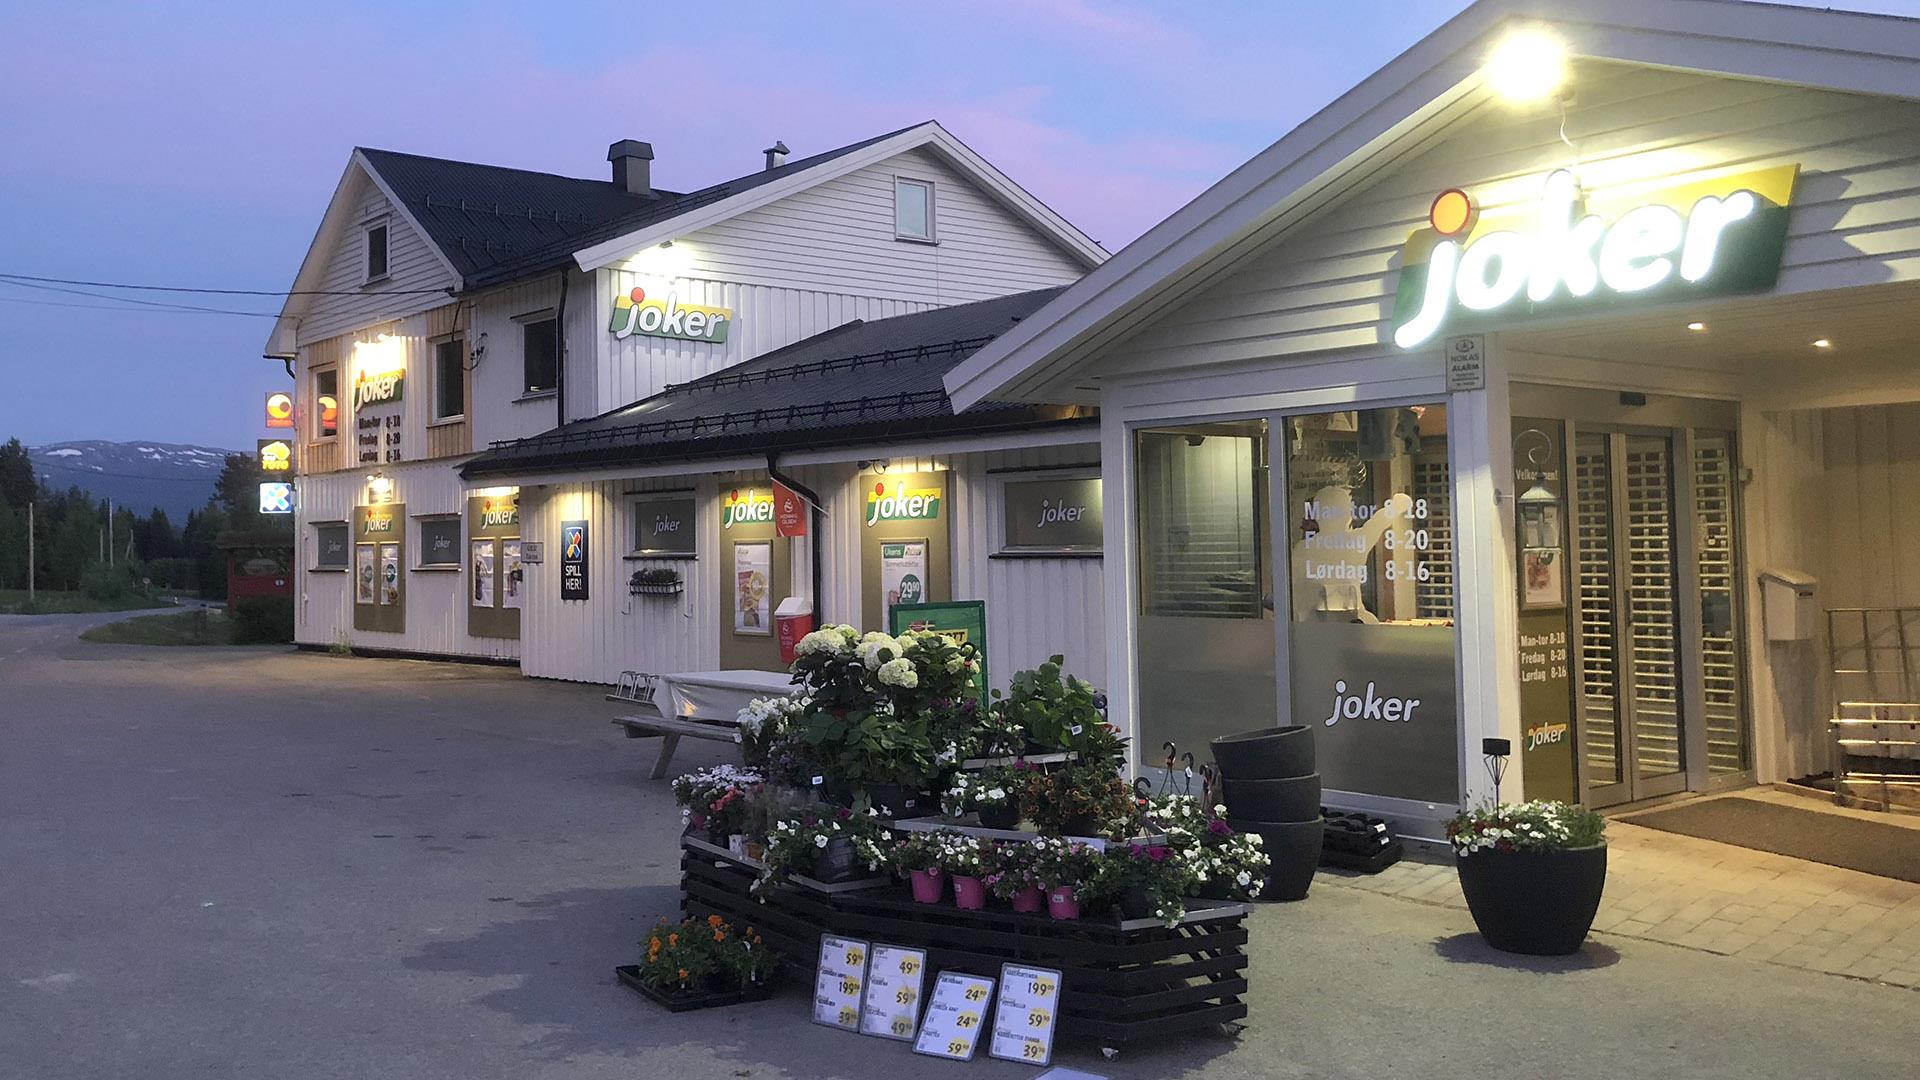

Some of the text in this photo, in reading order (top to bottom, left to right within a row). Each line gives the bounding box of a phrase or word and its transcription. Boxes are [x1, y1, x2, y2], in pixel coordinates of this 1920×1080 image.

[1394, 169, 1755, 348] joker
[616, 287, 725, 339] joker
[1452, 363, 1479, 371] ALARM
[355, 370, 399, 412] joker
[1516, 468, 1558, 480] Velkomen!
[866, 481, 936, 527] joker
[1037, 499, 1086, 528] joker
[1304, 498, 1428, 520] Mantor 818
[365, 510, 392, 535] joker
[481, 501, 516, 530] joker
[653, 514, 681, 536] joker
[433, 536, 451, 551] joker
[1384, 529, 1429, 550] 8-20
[565, 565, 582, 577] SPILL
[1305, 559, 1432, 583] Lørdag 8-16
[565, 578, 582, 590] HER!
[1521, 631, 1566, 646] Man-tor 8-18
[1521, 648, 1566, 664] Fredag 8-20
[1550, 666, 1567, 678] 8-16
[1325, 680, 1420, 726] joker
[1528, 722, 1566, 751] joker
